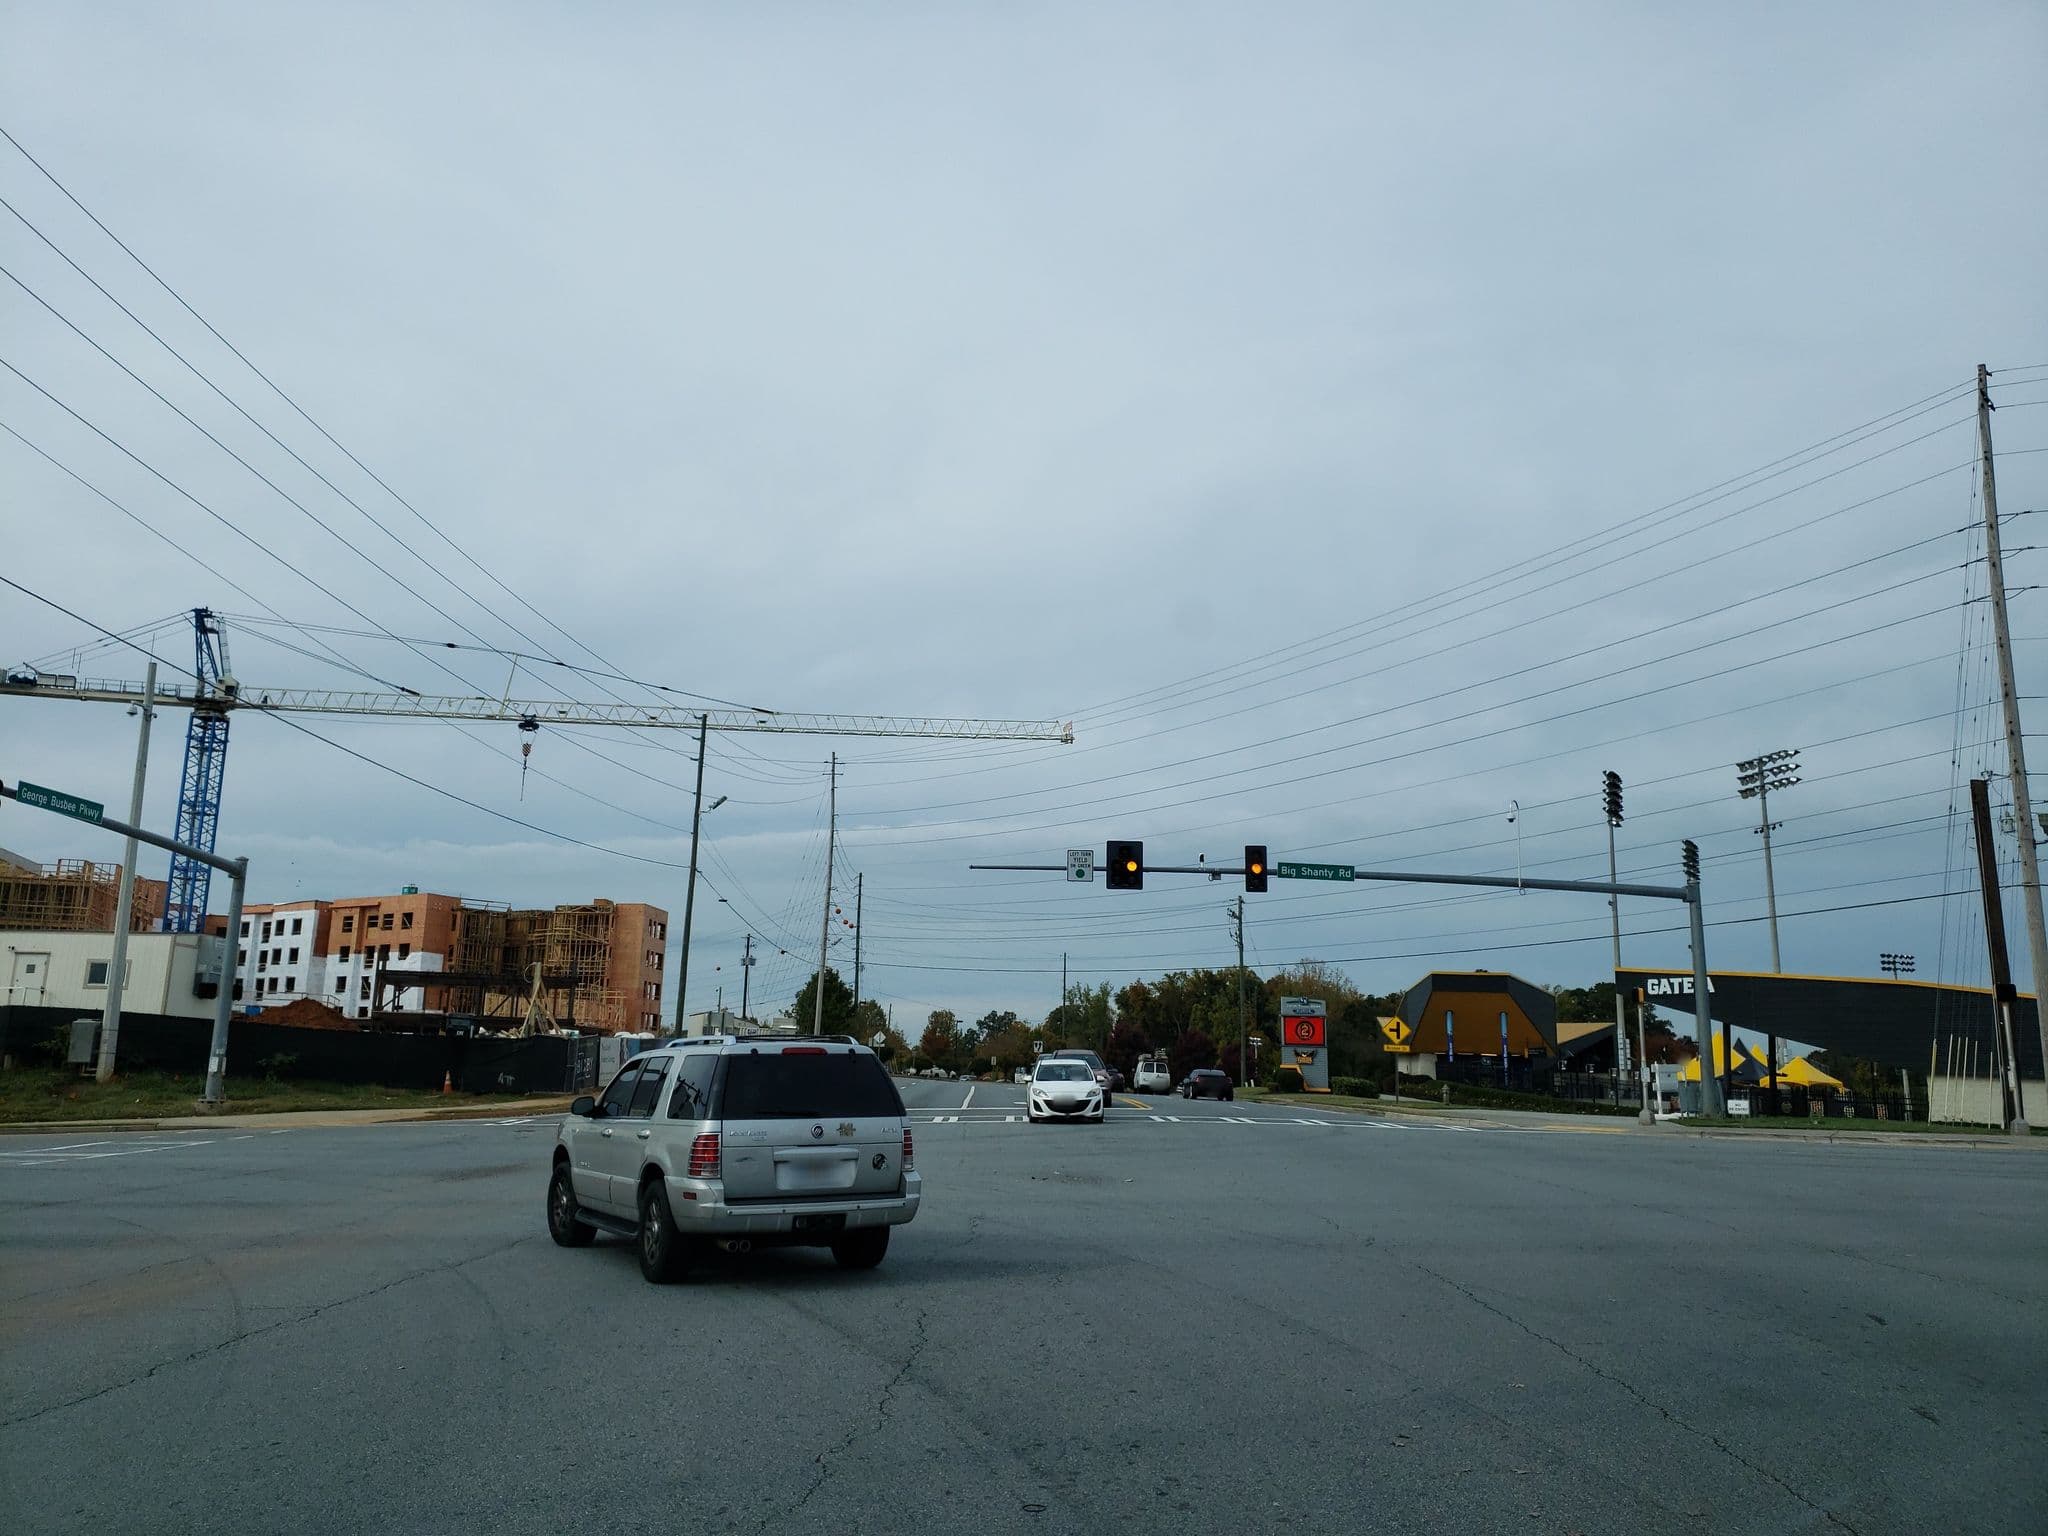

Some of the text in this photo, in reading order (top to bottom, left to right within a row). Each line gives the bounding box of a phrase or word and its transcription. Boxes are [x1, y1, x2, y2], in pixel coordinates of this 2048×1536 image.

[21, 787, 100, 819] George Busbee Pkwy
[1281, 866, 1352, 879] Big Shanty Rd
[1647, 977, 1694, 995] GATE
